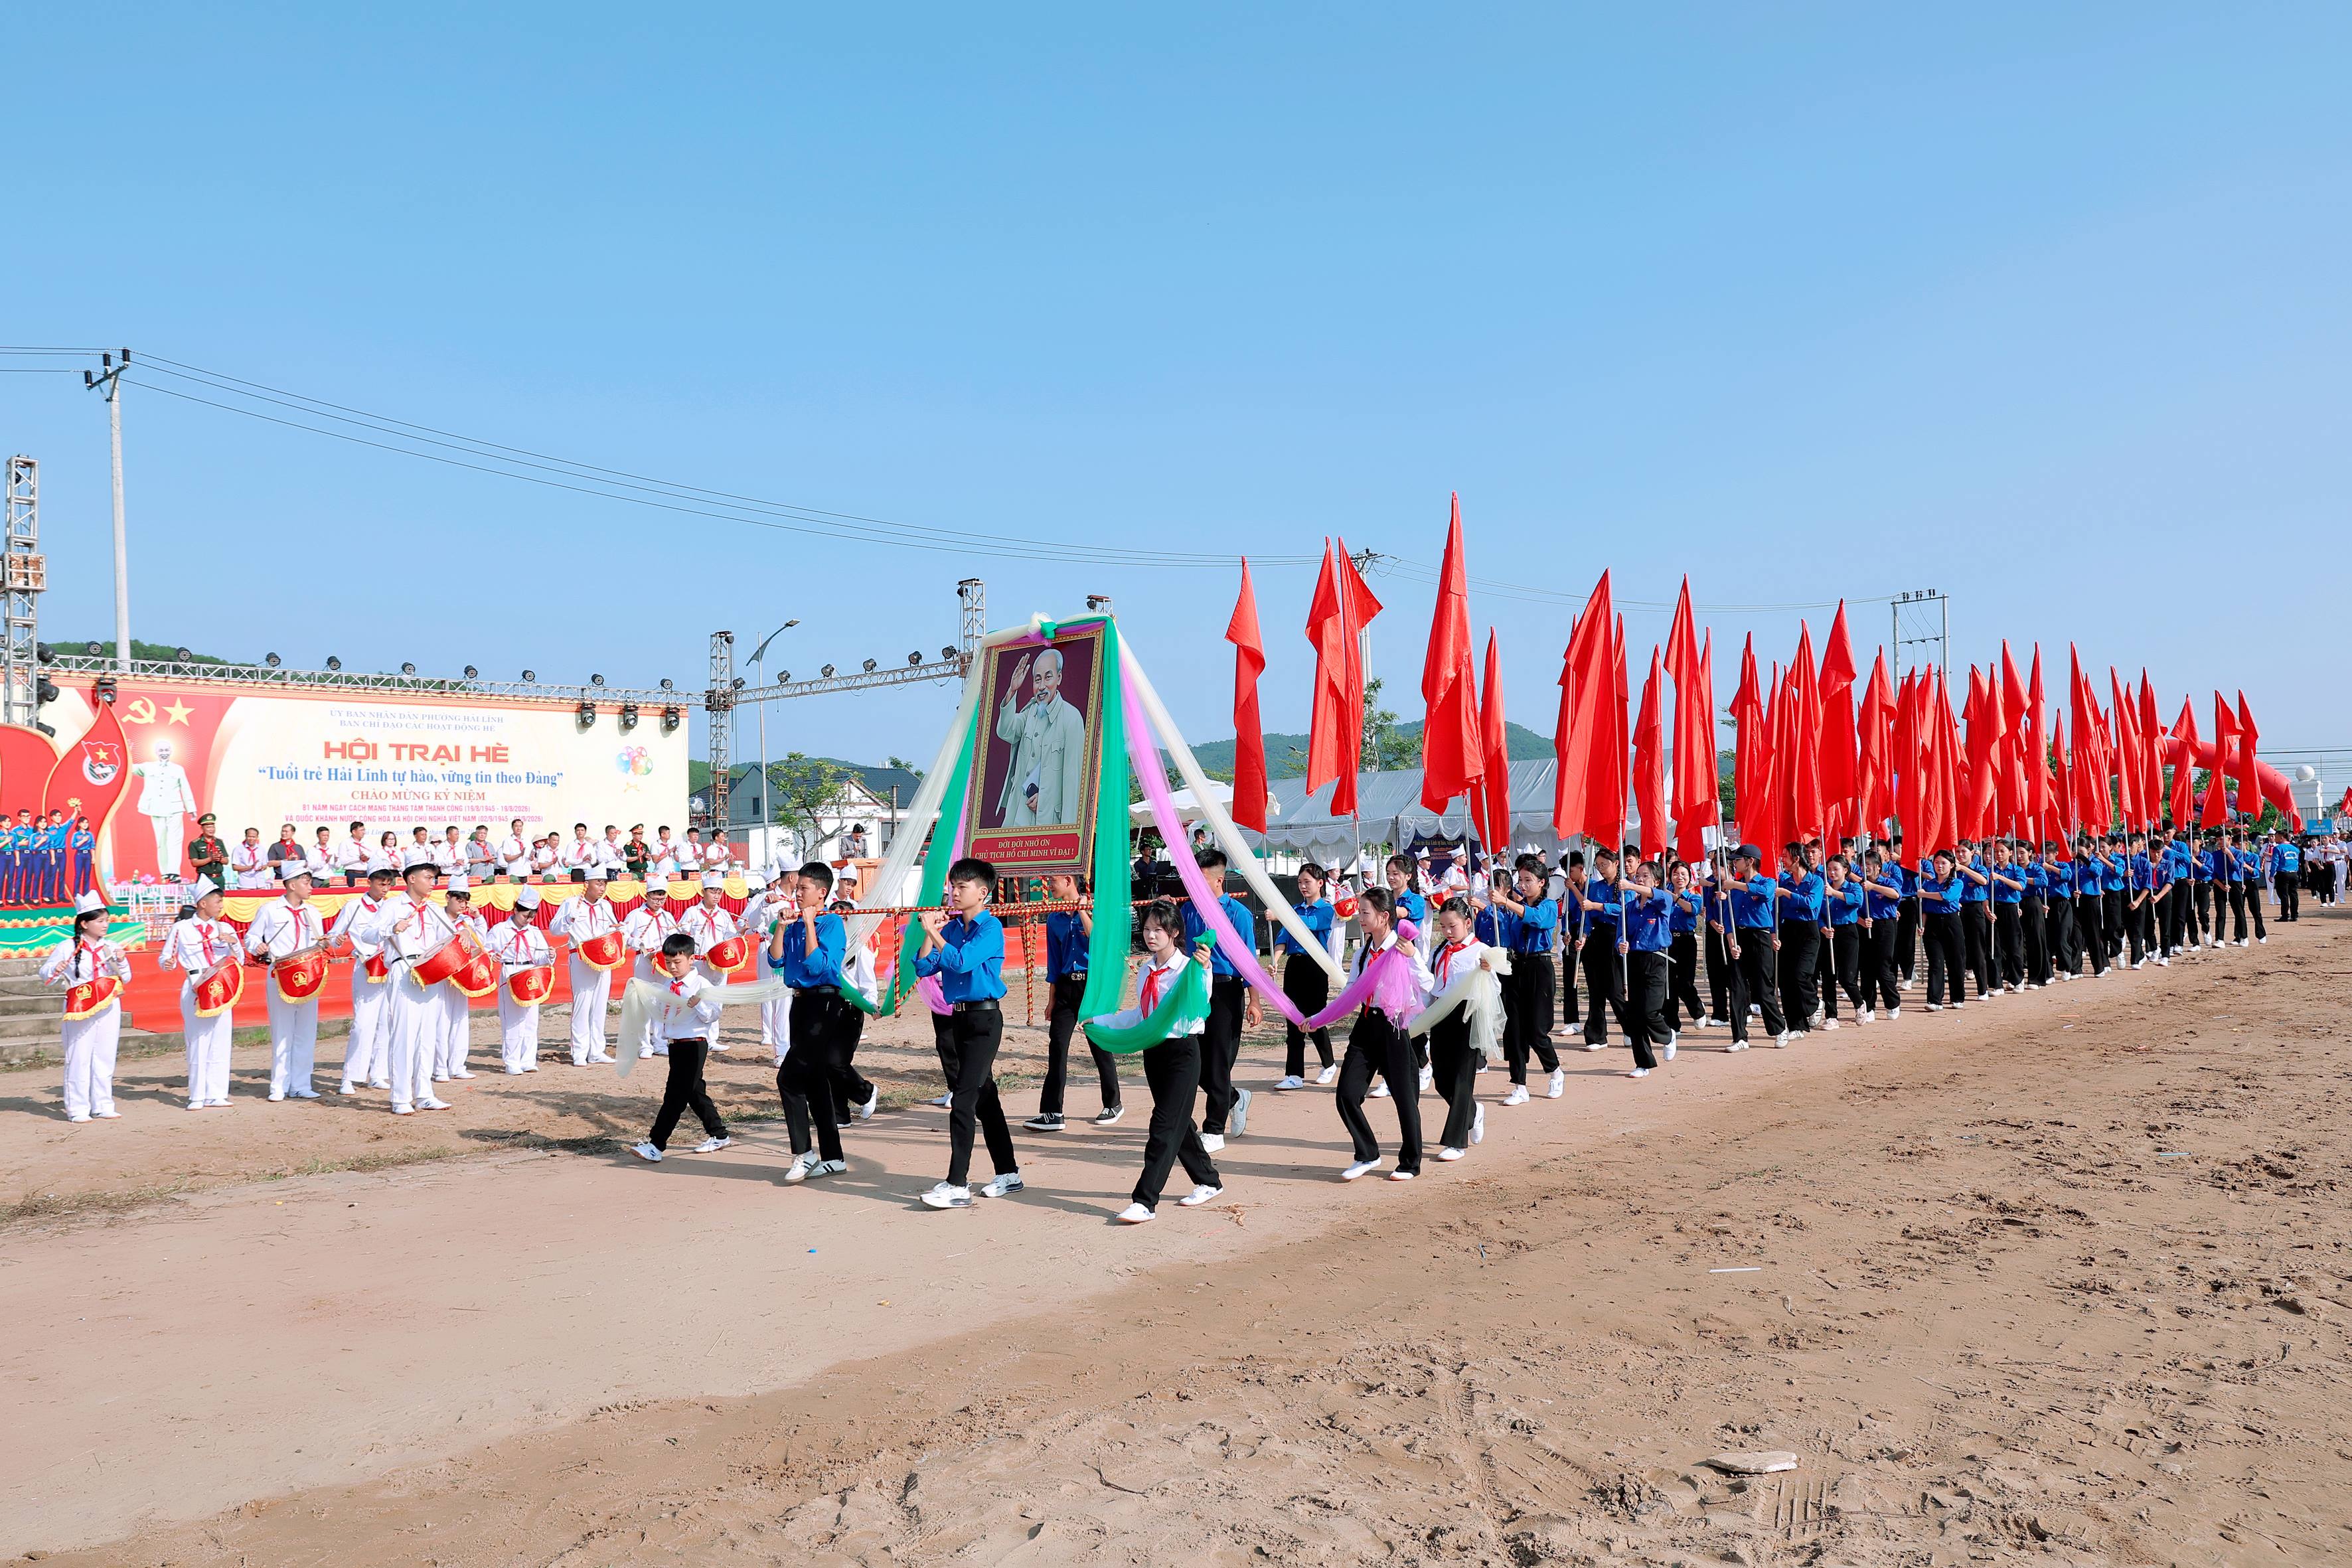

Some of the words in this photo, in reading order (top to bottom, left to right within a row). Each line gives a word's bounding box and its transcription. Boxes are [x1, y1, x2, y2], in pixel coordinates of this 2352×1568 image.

[369, 710, 397, 719] NHÂN
[399, 712, 419, 720] DÂN
[324, 737, 378, 764] HỘI
[388, 743, 460, 765] TRẠI
[470, 742, 509, 763] HÈ
[303, 766, 323, 781] trẻ
[327, 766, 352, 781] Hải
[356, 768, 388, 781] Lĩnh
[392, 770, 407, 786] tự
[410, 769, 437, 784] hào,
[441, 769, 471, 785] vững
[475, 771, 492, 783] tin
[496, 771, 522, 784] theo
[351, 788, 388, 800] CHÀO
[392, 788, 430, 801] MỪNG
[434, 788, 450, 801] KỶ
[454, 789, 487, 803] NIỆM
[447, 803, 463, 812] CÔNG
[998, 839, 1010, 848] ĐỜI
[1011, 838, 1023, 848] ĐỜI
[1024, 838, 1040, 847] NHỚ
[975, 850, 989, 859] CHỦ
[989, 851, 1004, 860] TỊCH
[1006, 848, 1016, 858] HỒ
[1017, 848, 1029, 858] CHÍ
[1058, 848, 1070, 857] ĐẠI
